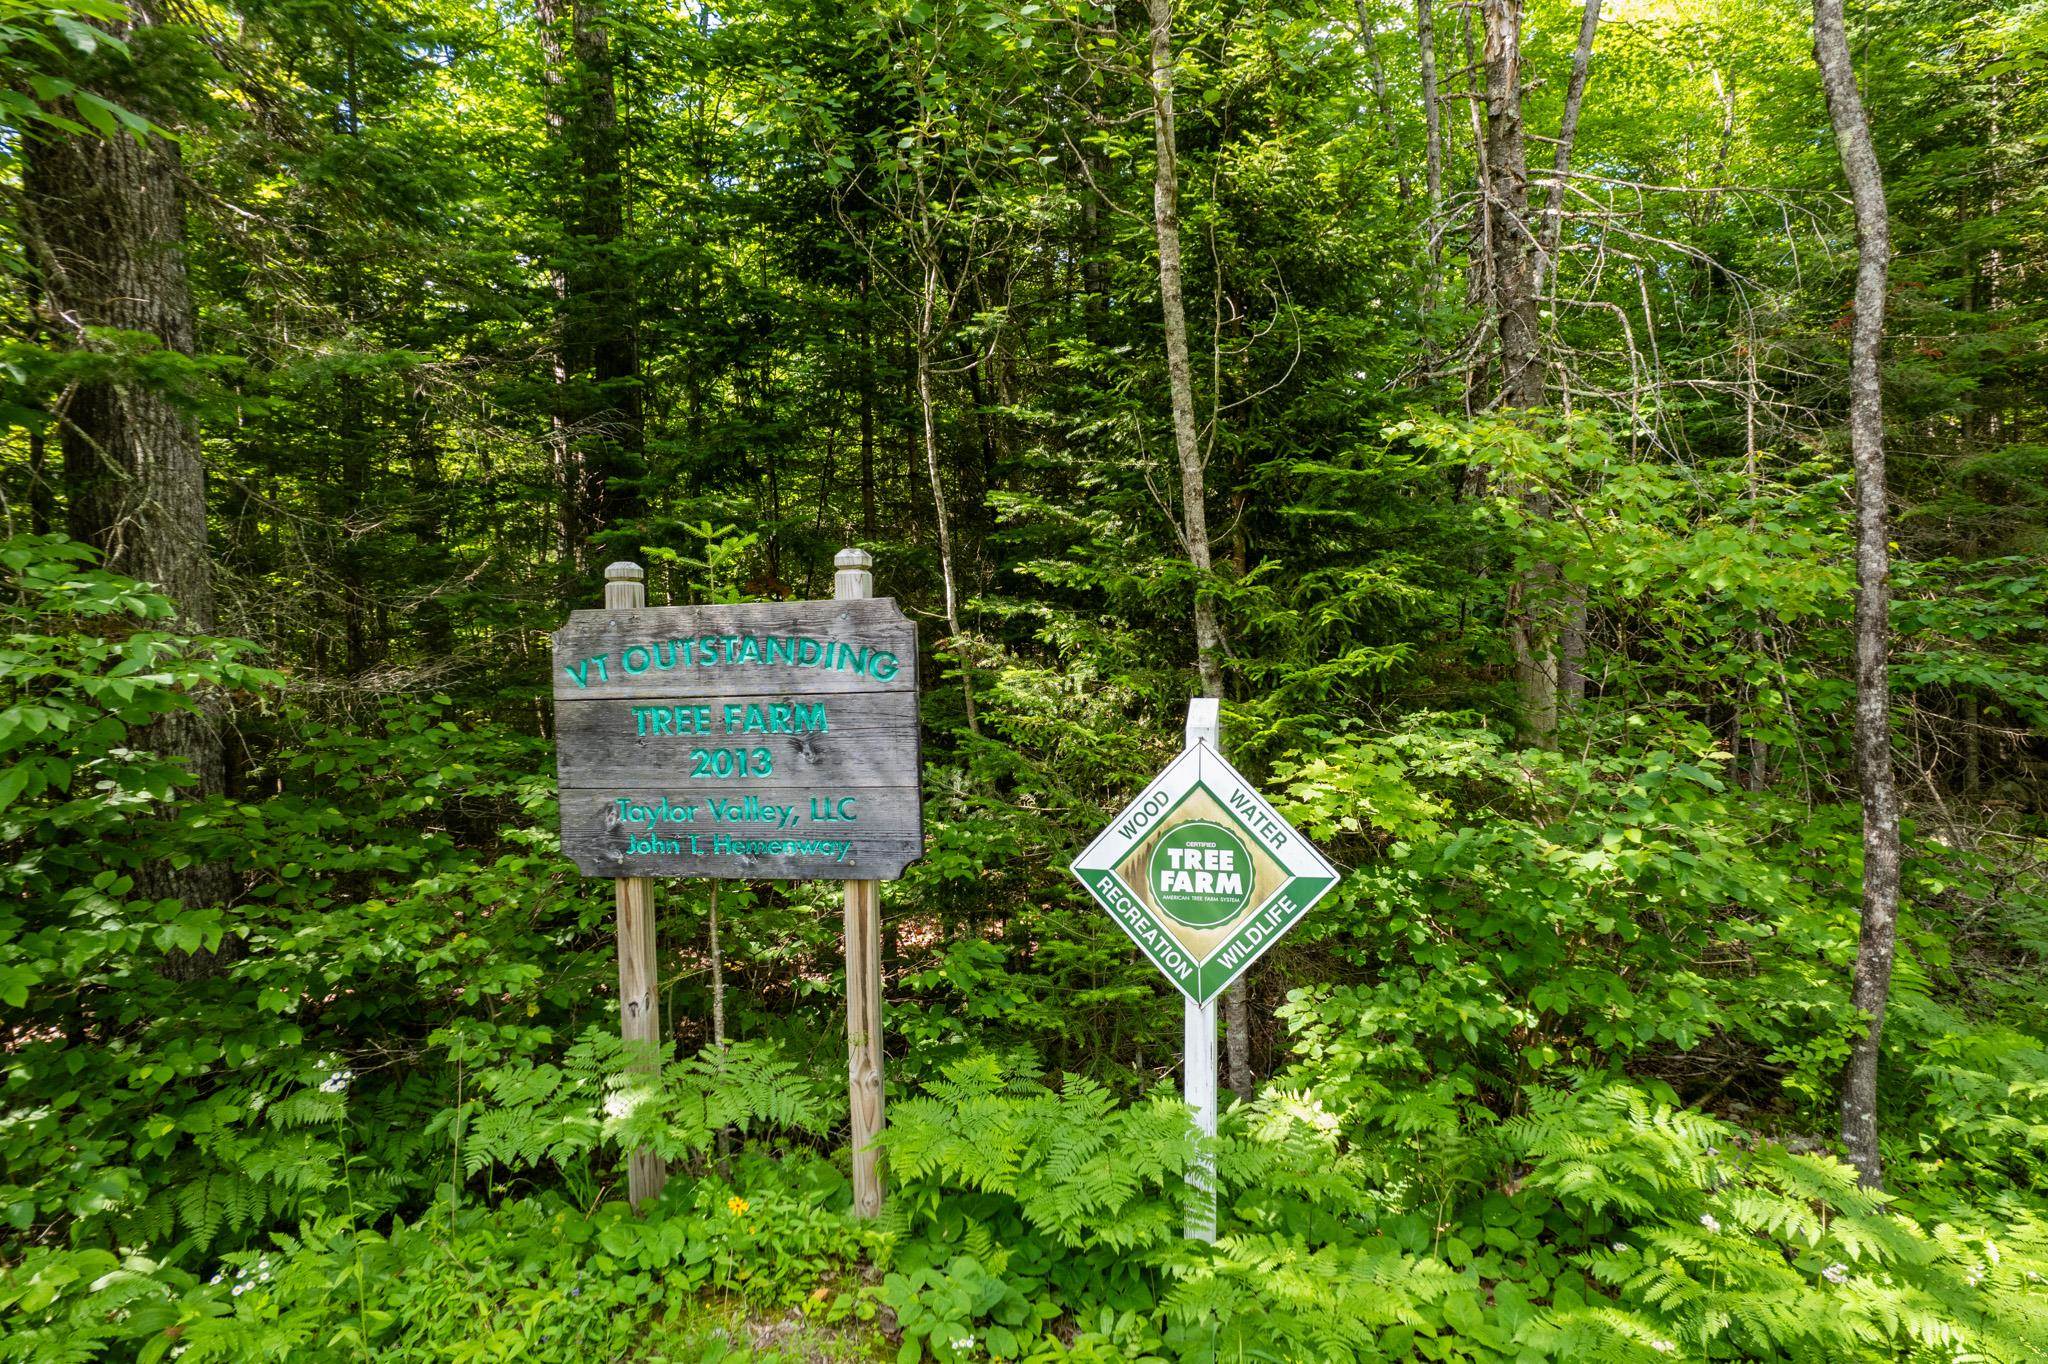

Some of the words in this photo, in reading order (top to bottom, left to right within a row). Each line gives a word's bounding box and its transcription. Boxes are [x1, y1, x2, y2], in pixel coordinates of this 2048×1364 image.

[565, 653, 609, 689] VT
[621, 635, 899, 683] OUTSTANDING
[631, 705, 711, 737] TREE
[723, 702, 829, 734] FARM
[690, 747, 774, 778] 2013
[615, 796, 699, 830] Taylor
[707, 795, 800, 830] Valley,
[810, 796, 857, 822] LLC
[1117, 789, 1170, 841] WOOD
[1227, 787, 1288, 851] WATER
[625, 831, 680, 855] John
[713, 832, 852, 862] Hemenway
[1167, 848, 1234, 871] TREE
[1160, 870, 1244, 895] FARM
[1096, 876, 1193, 981] RECREATION
[1216, 894, 1298, 971] WILDLIFE
